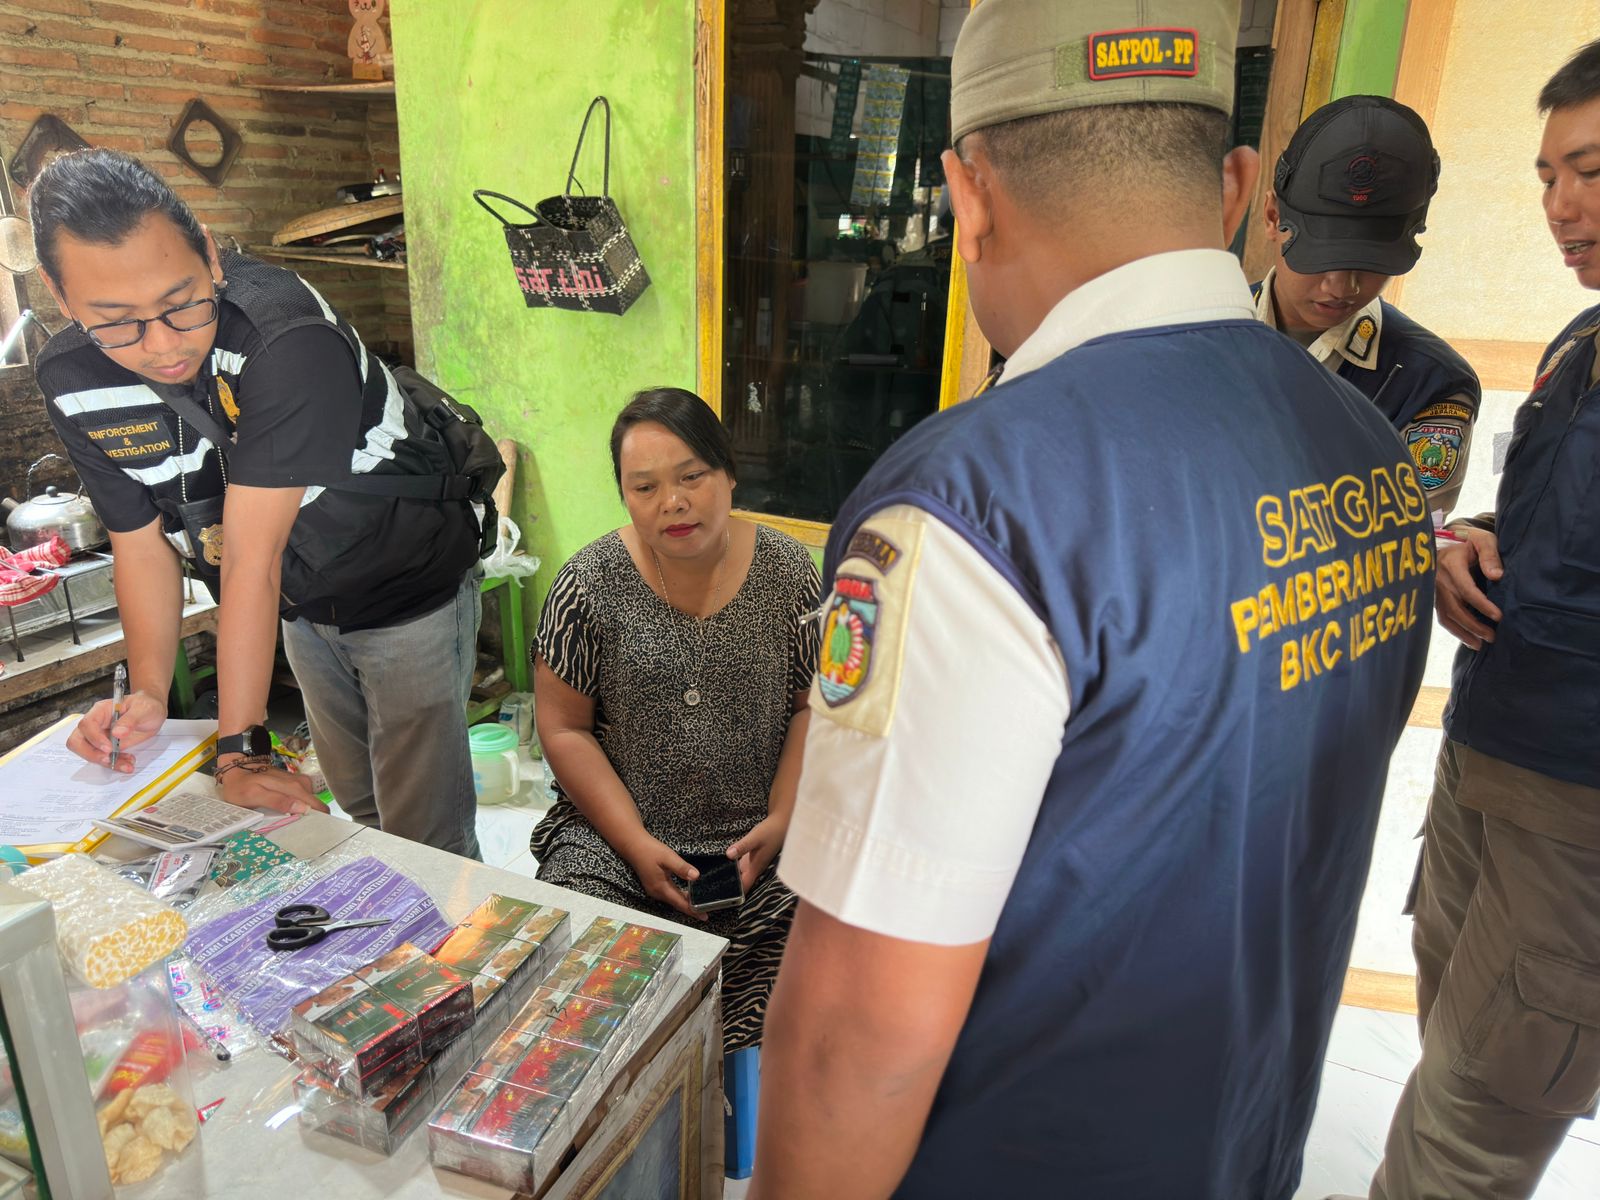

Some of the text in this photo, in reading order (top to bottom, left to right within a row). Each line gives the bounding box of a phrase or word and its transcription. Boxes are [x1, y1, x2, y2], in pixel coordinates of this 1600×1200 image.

[88, 421, 158, 439] ENFORCEMENT
[104, 440, 170, 458] VESTIGATION
[123, 437, 132, 446] &
[1255, 462, 1426, 568] SATGAS
[1230, 531, 1435, 654] PEMBERANTAS
[1280, 588, 1418, 692] BKC ILEGAL
[334, 901, 357, 920] BUMI
[355, 874, 388, 902] KARTINI
[401, 905, 422, 923] BUMI
[197, 942, 223, 962] BUMI
[222, 916, 261, 944] KARTINI
[268, 893, 294, 913] BUMI
